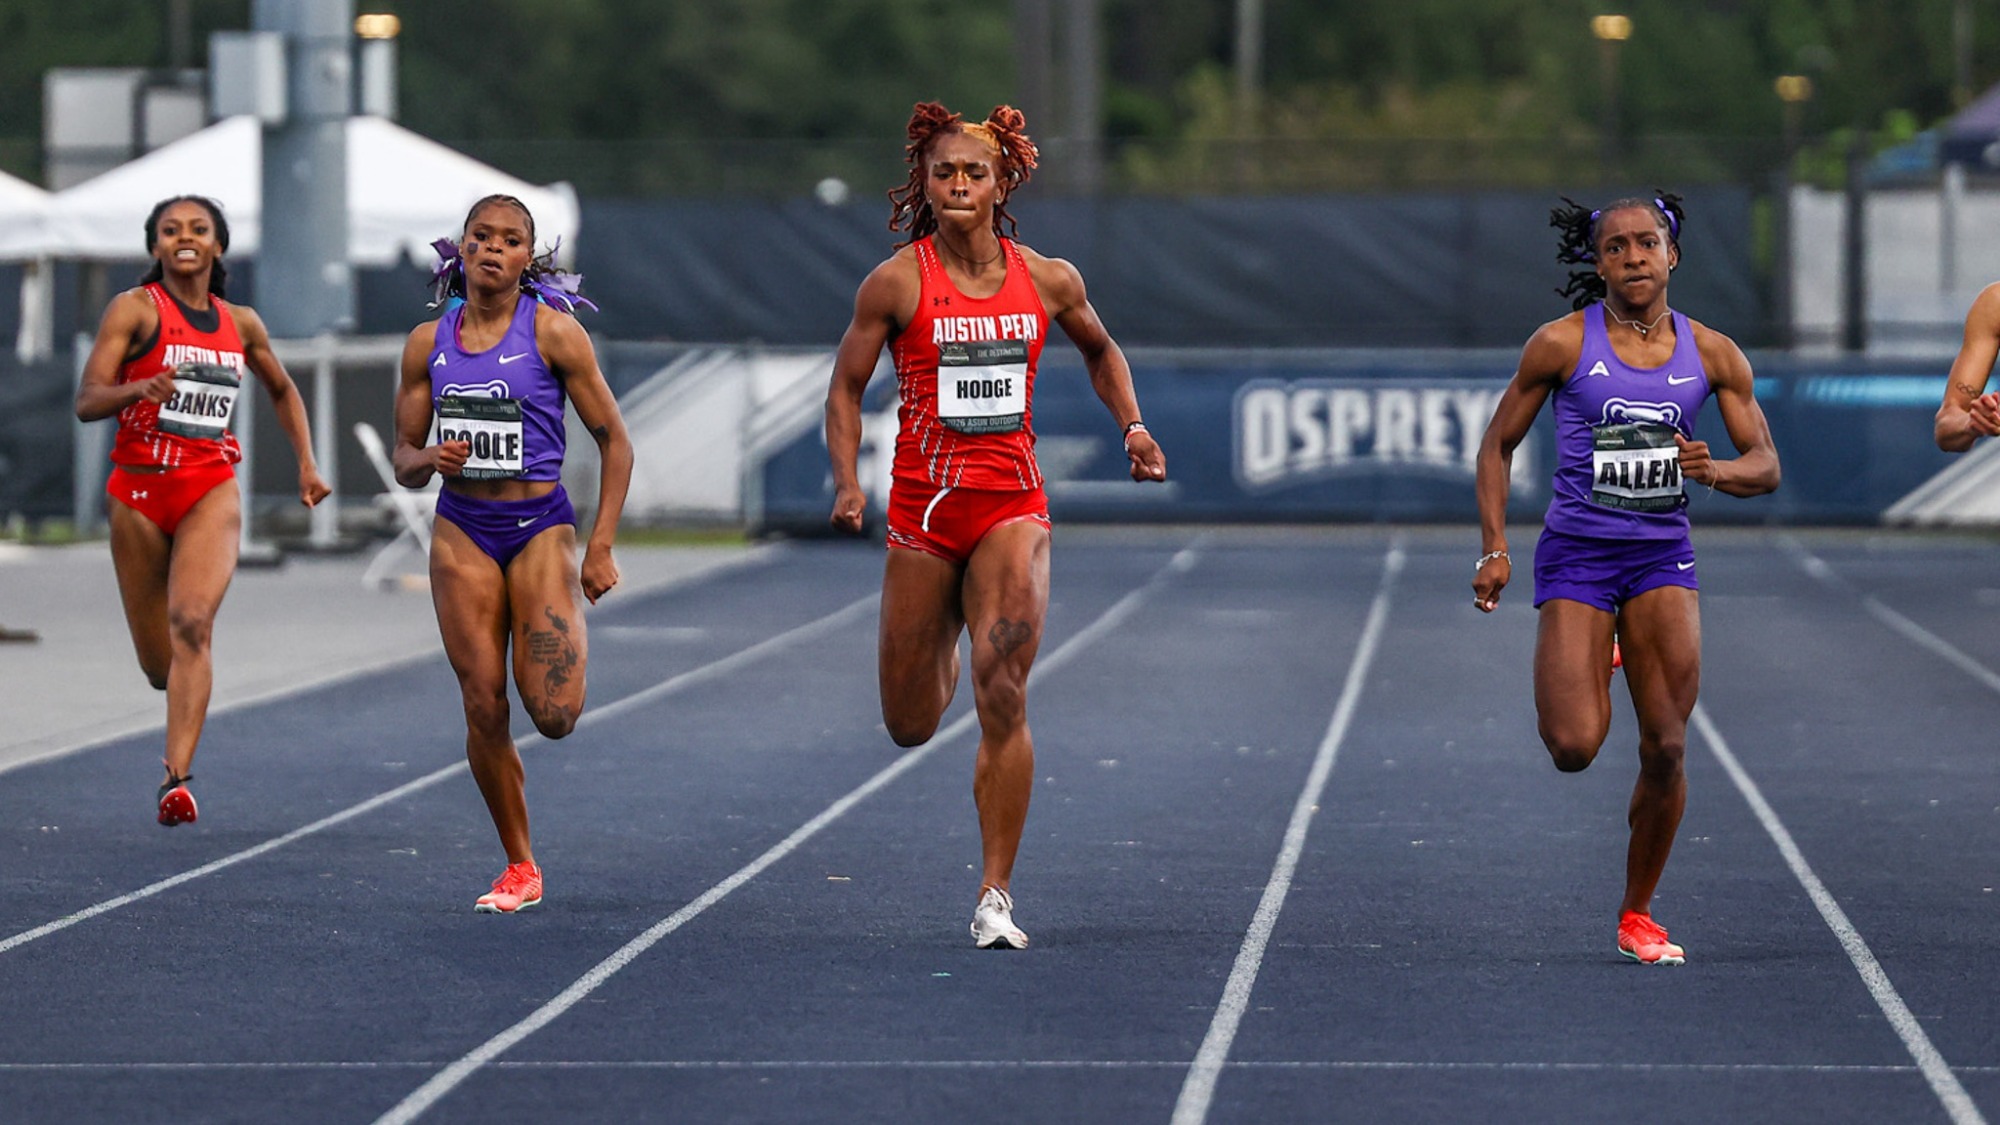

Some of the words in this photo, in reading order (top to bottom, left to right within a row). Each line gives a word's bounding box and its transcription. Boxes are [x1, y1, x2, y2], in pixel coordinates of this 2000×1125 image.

[933, 315, 997, 344] AUSTIN
[999, 313, 1038, 340] PEAY
[162, 344, 220, 367] AUSTIN
[957, 378, 1012, 399] HODGE
[165, 391, 231, 418] BANKS
[1243, 387, 1536, 496] OSPREY
[1598, 457, 1679, 490] ALLEN
